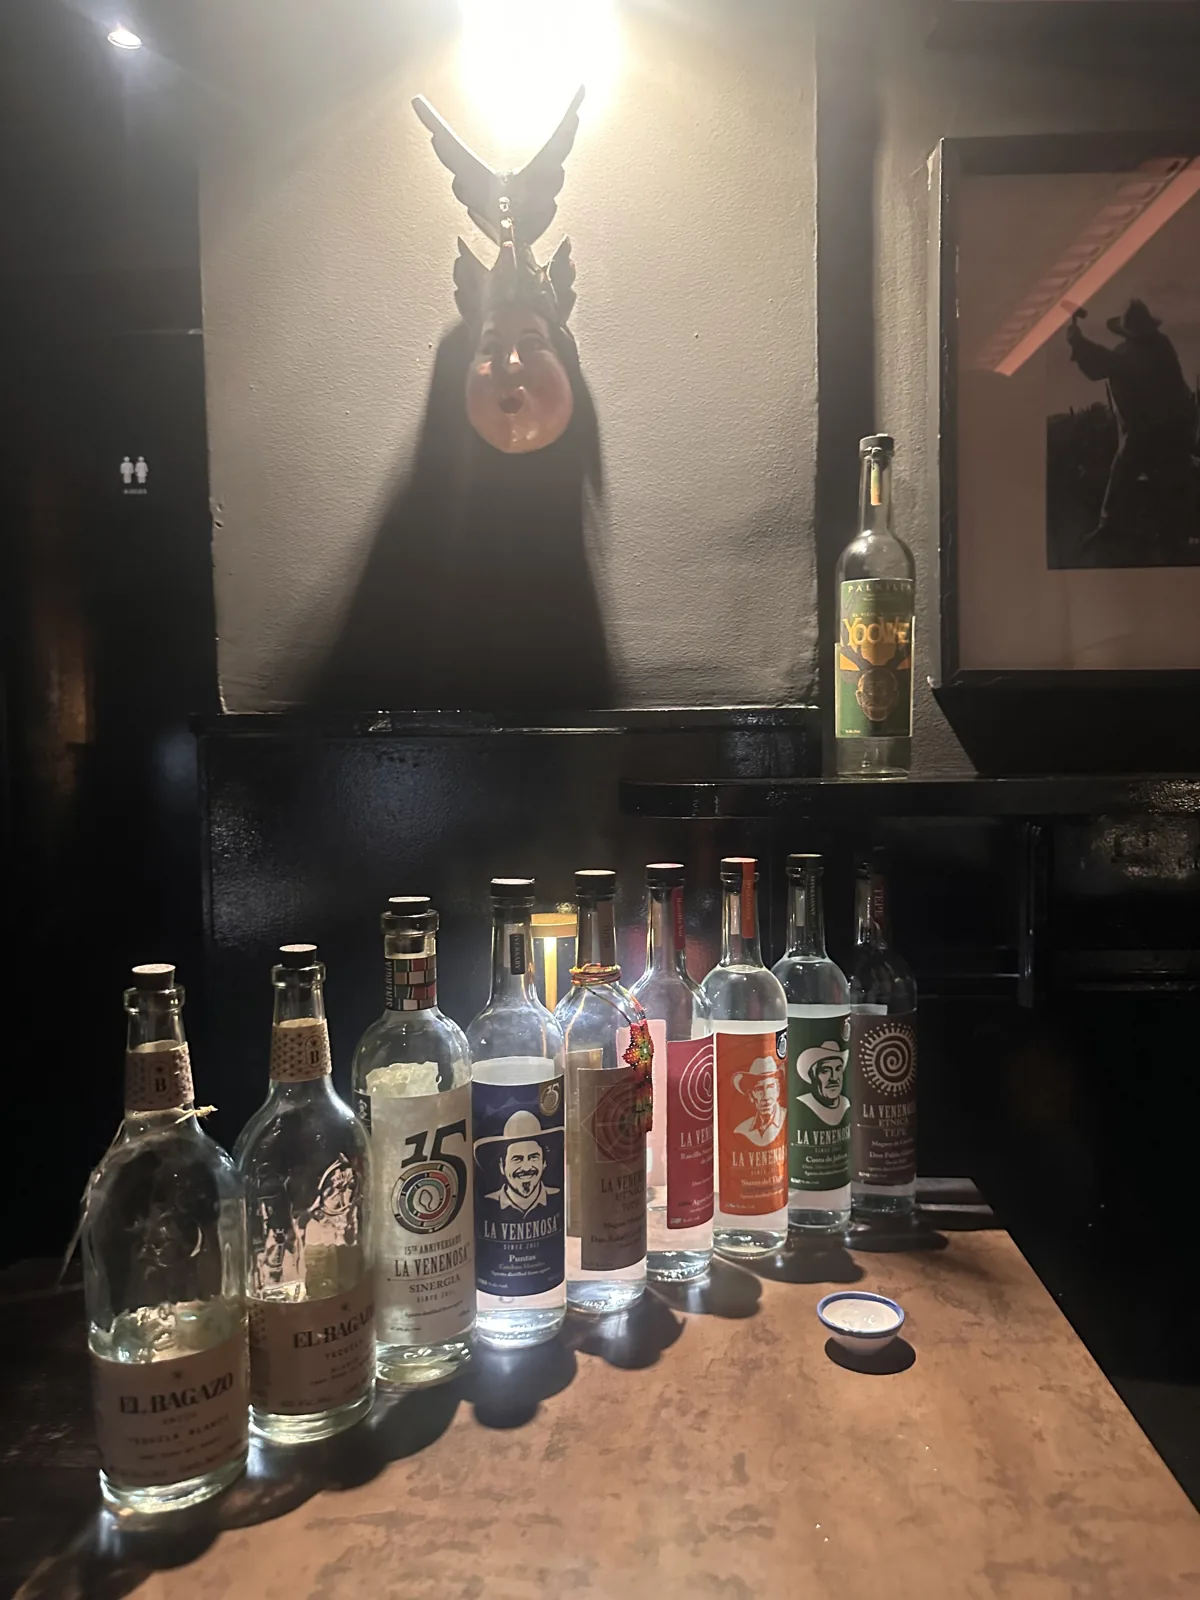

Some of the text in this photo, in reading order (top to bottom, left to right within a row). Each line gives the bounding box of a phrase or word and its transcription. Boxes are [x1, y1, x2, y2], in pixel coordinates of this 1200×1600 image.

[310, 1050, 321, 1066] B
[155, 1078, 167, 1094] B
[863, 1103, 876, 1119] LA
[680, 1131, 693, 1148] LA
[797, 1129, 810, 1145] LA
[732, 1151, 745, 1167] LA
[601, 1178, 614, 1194] LA
[483, 1215, 559, 1241] LA VENENOSA
[394, 1246, 468, 1278] LA VENENOSA
[508, 1254, 537, 1263] Puntas
[409, 1273, 461, 1294] SINERGIA
[293, 1330, 321, 1349] EL
[119, 1372, 234, 1415] EL BAGAZO
